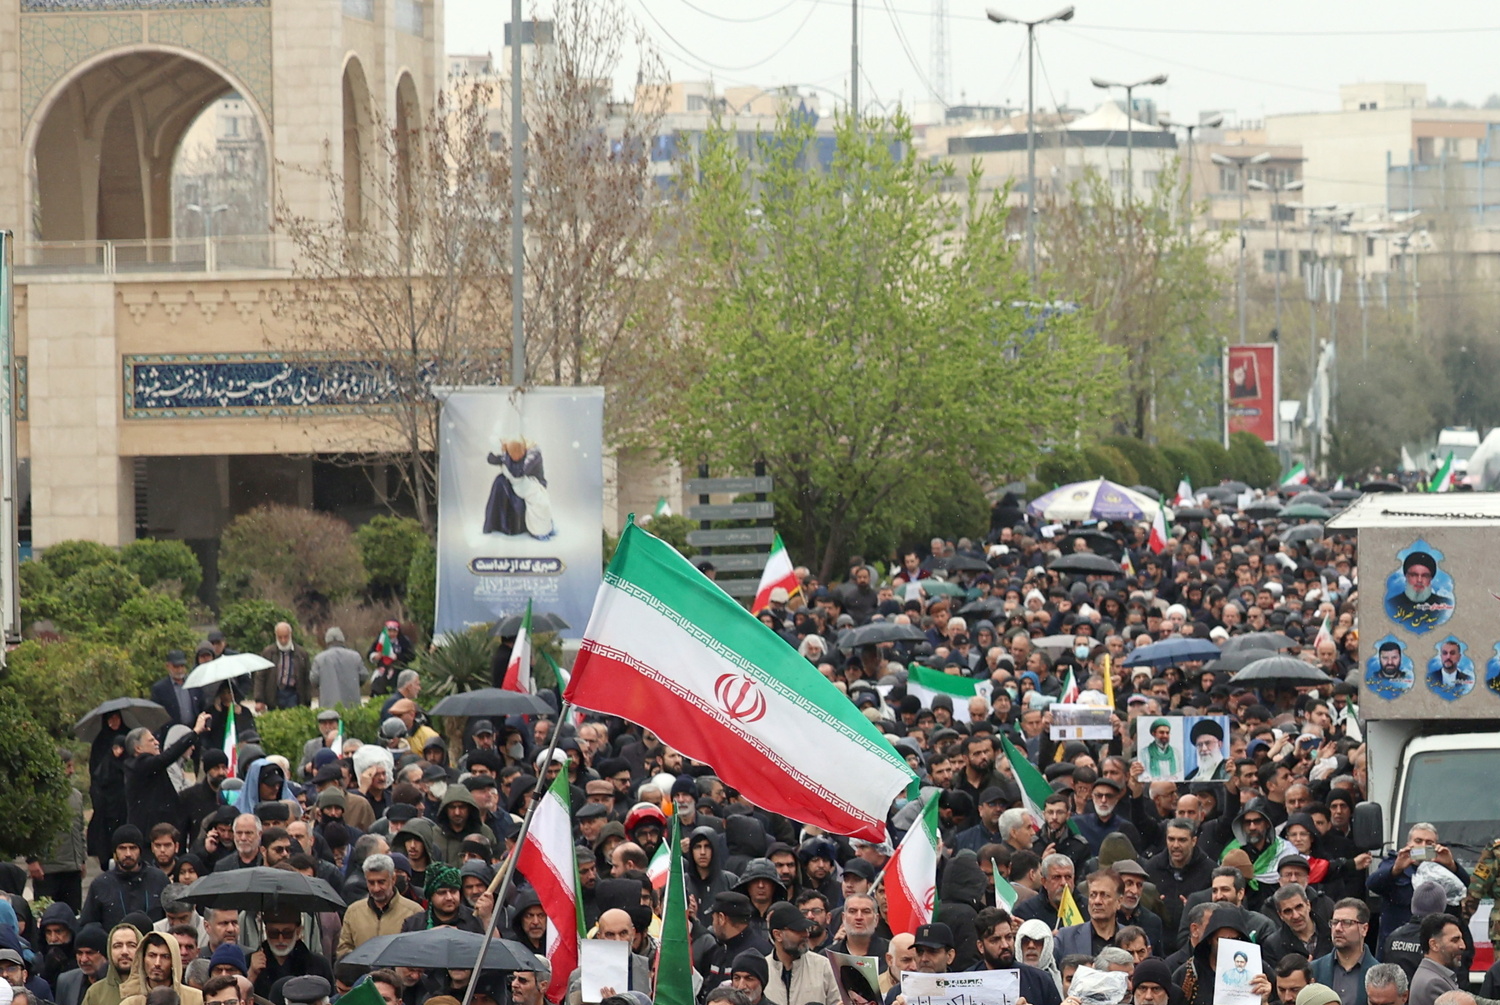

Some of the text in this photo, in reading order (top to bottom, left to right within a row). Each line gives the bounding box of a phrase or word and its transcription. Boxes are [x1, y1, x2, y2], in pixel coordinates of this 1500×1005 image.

[475, 558, 558, 573] صبری که از خداست
[1391, 940, 1421, 953] SECURIT
